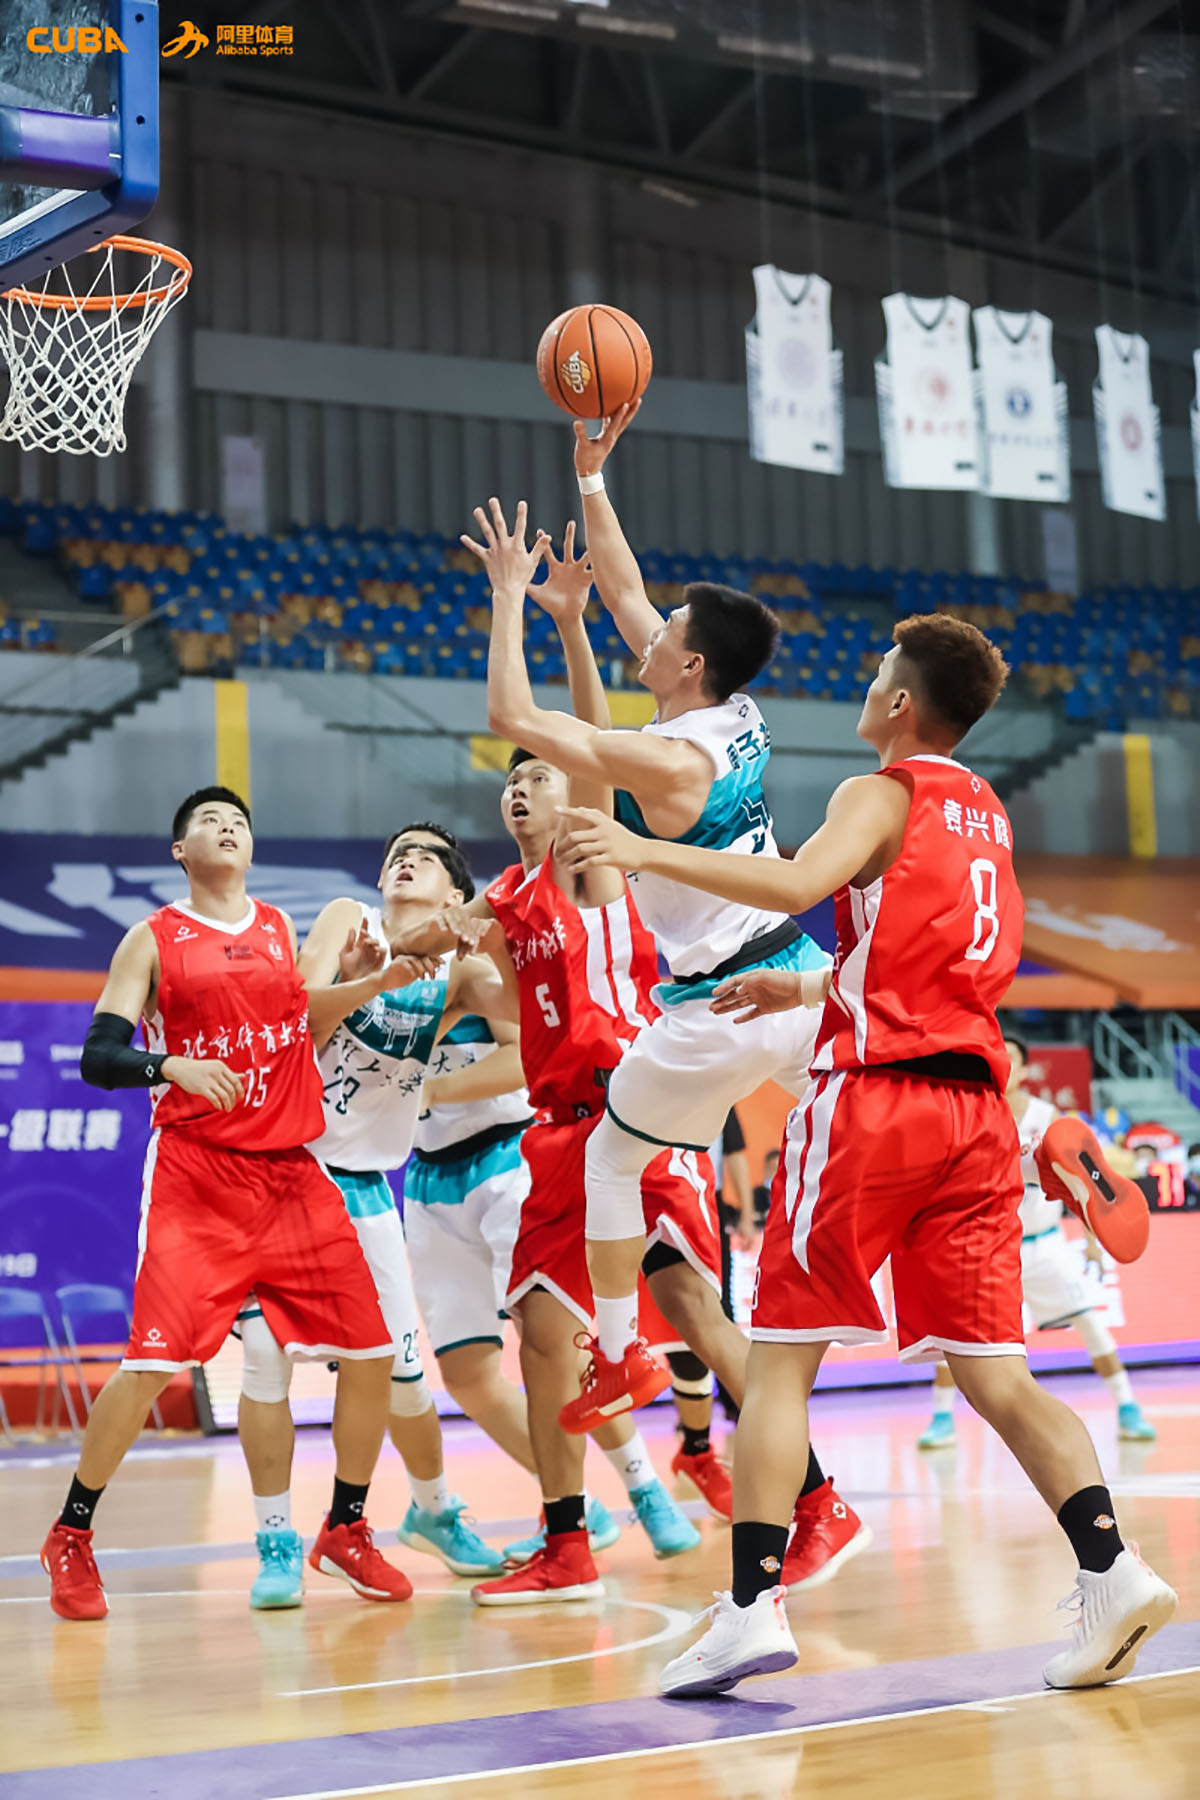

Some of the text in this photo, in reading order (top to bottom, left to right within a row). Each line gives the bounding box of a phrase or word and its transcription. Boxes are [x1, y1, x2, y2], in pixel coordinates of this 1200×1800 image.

[568, 350, 585, 394] CUBA
[963, 857, 1000, 963] 8
[535, 983, 561, 1028] 5
[242, 1066, 271, 1108] 15
